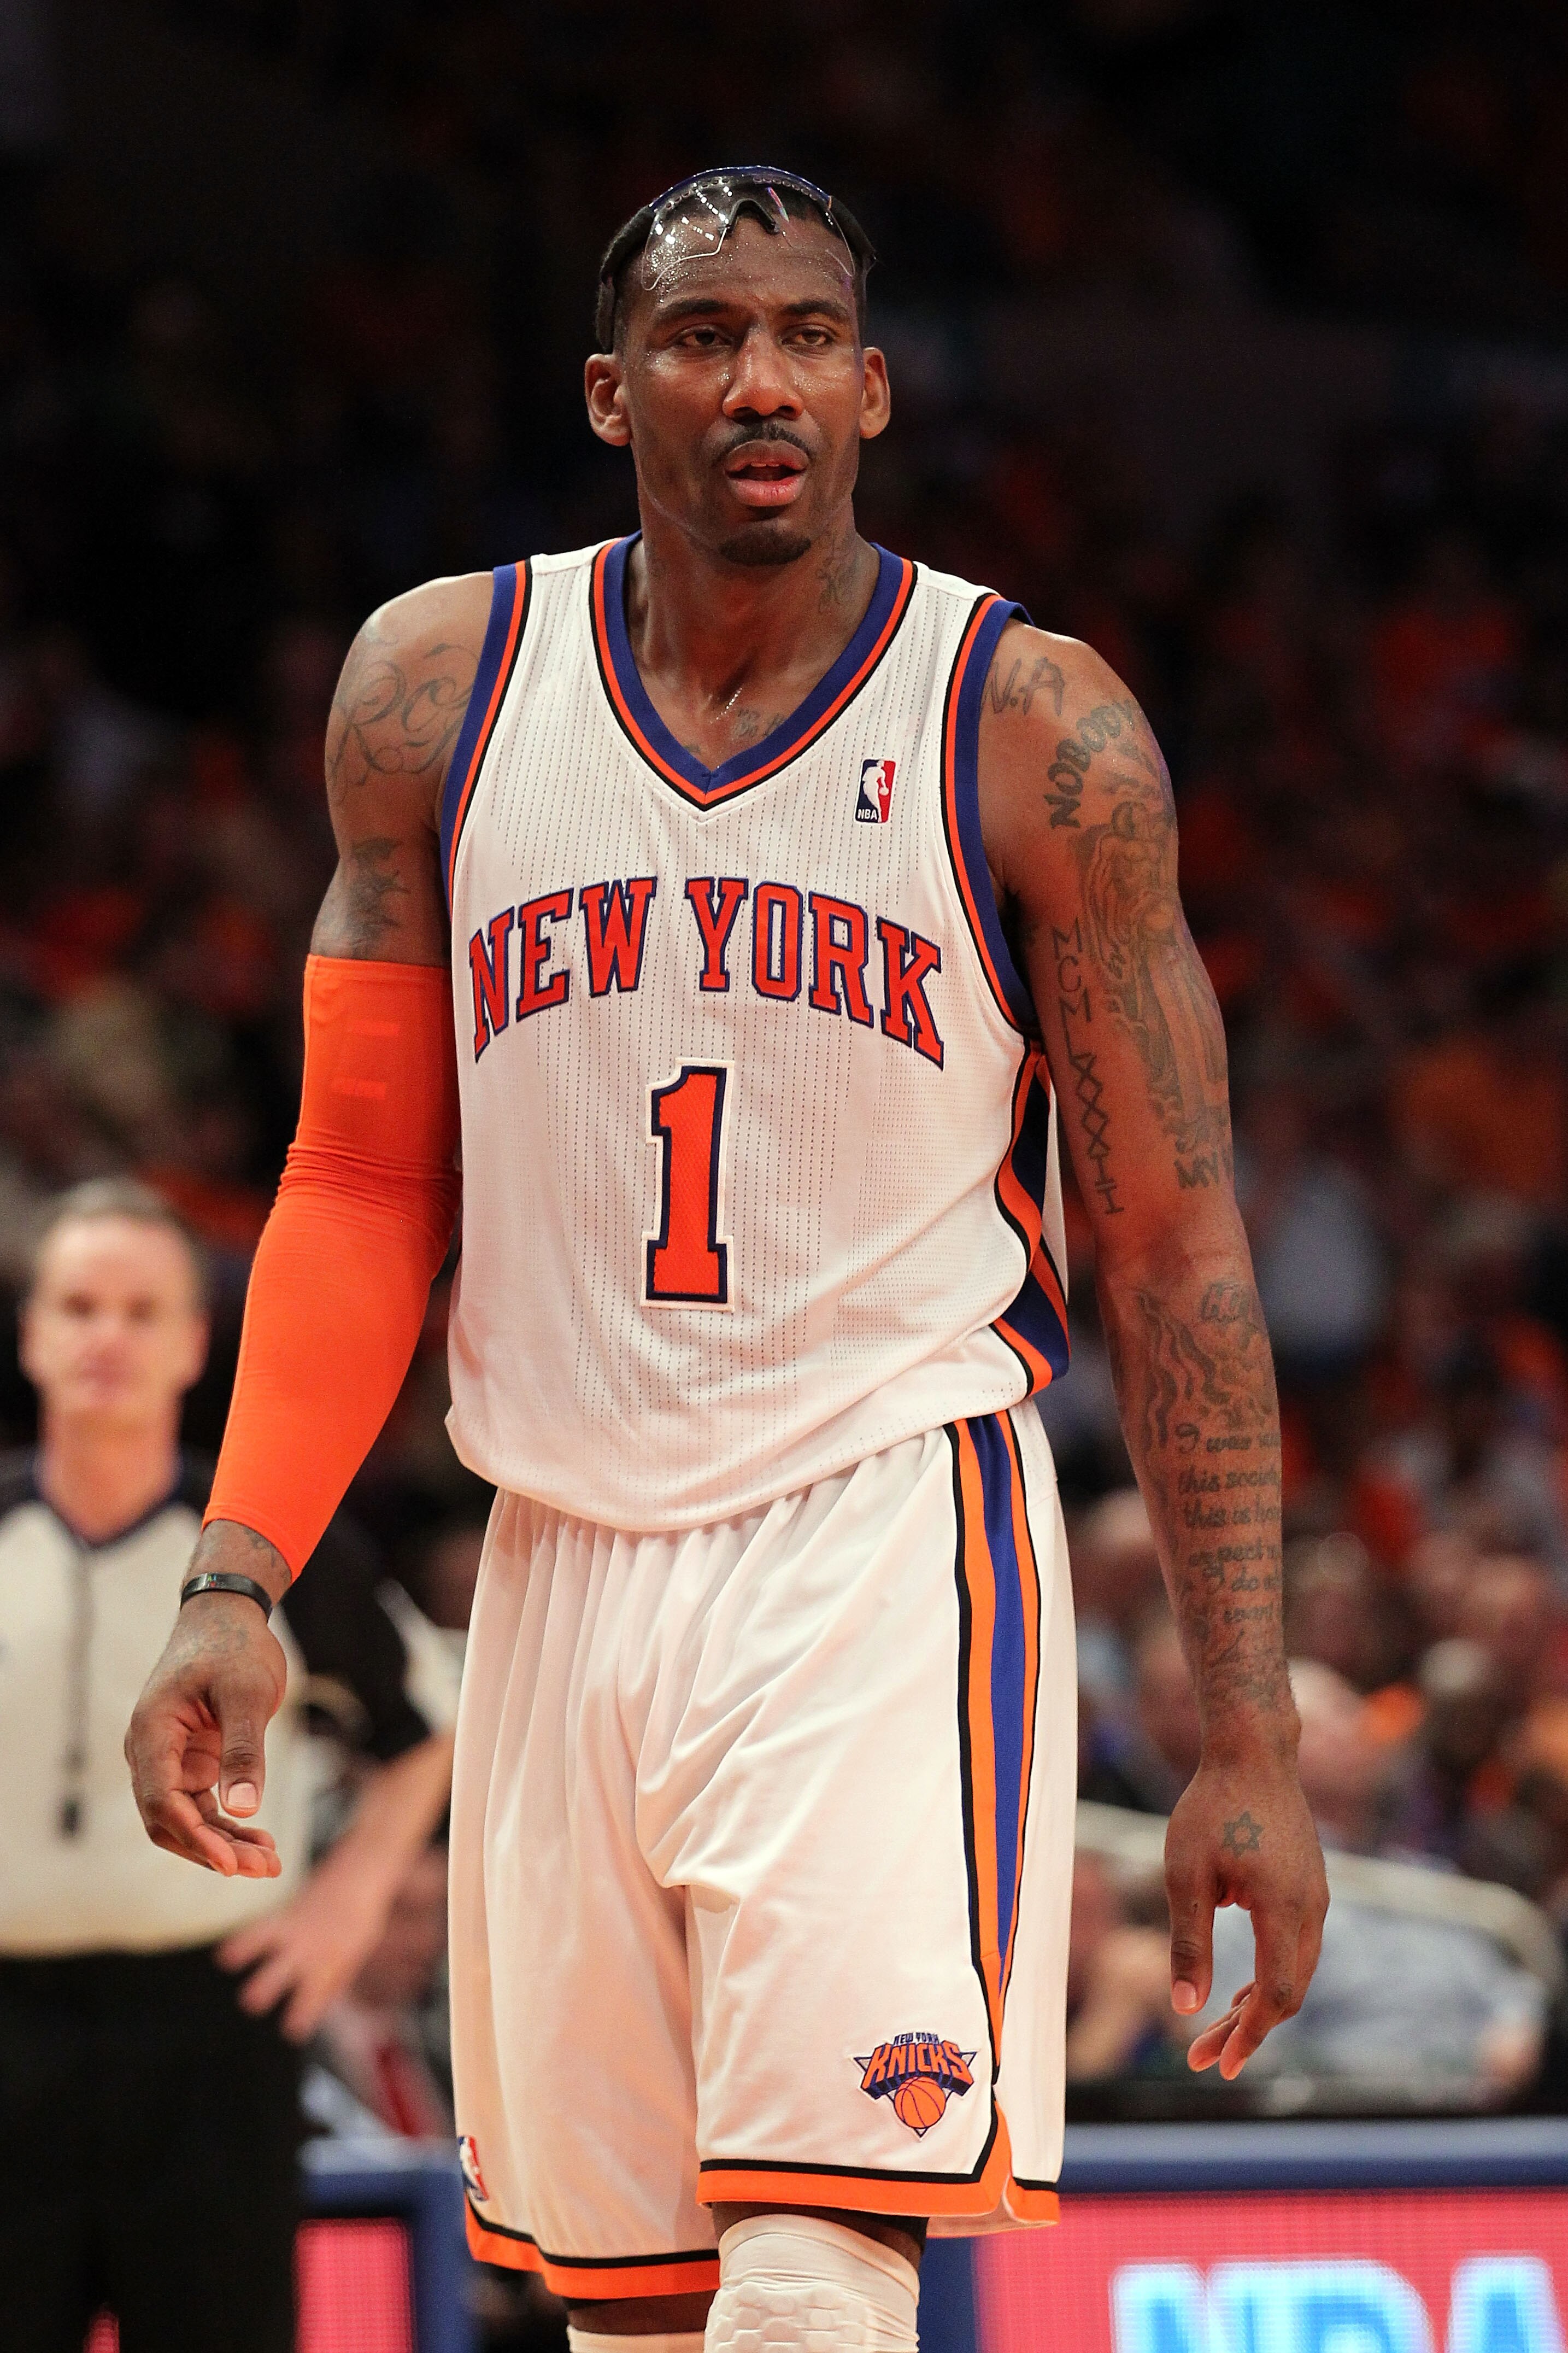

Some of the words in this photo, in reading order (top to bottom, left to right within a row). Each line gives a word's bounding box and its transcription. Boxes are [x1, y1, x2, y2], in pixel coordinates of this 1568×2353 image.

[857, 809, 878, 820] NBA
[469, 876, 656, 1063] NEW
[685, 877, 944, 1071] YORK
[644, 1062, 731, 1307] 1
[893, 2033, 913, 2045] NEW
[915, 2032, 939, 2045] YORK
[860, 2040, 974, 2099] KNICKS
